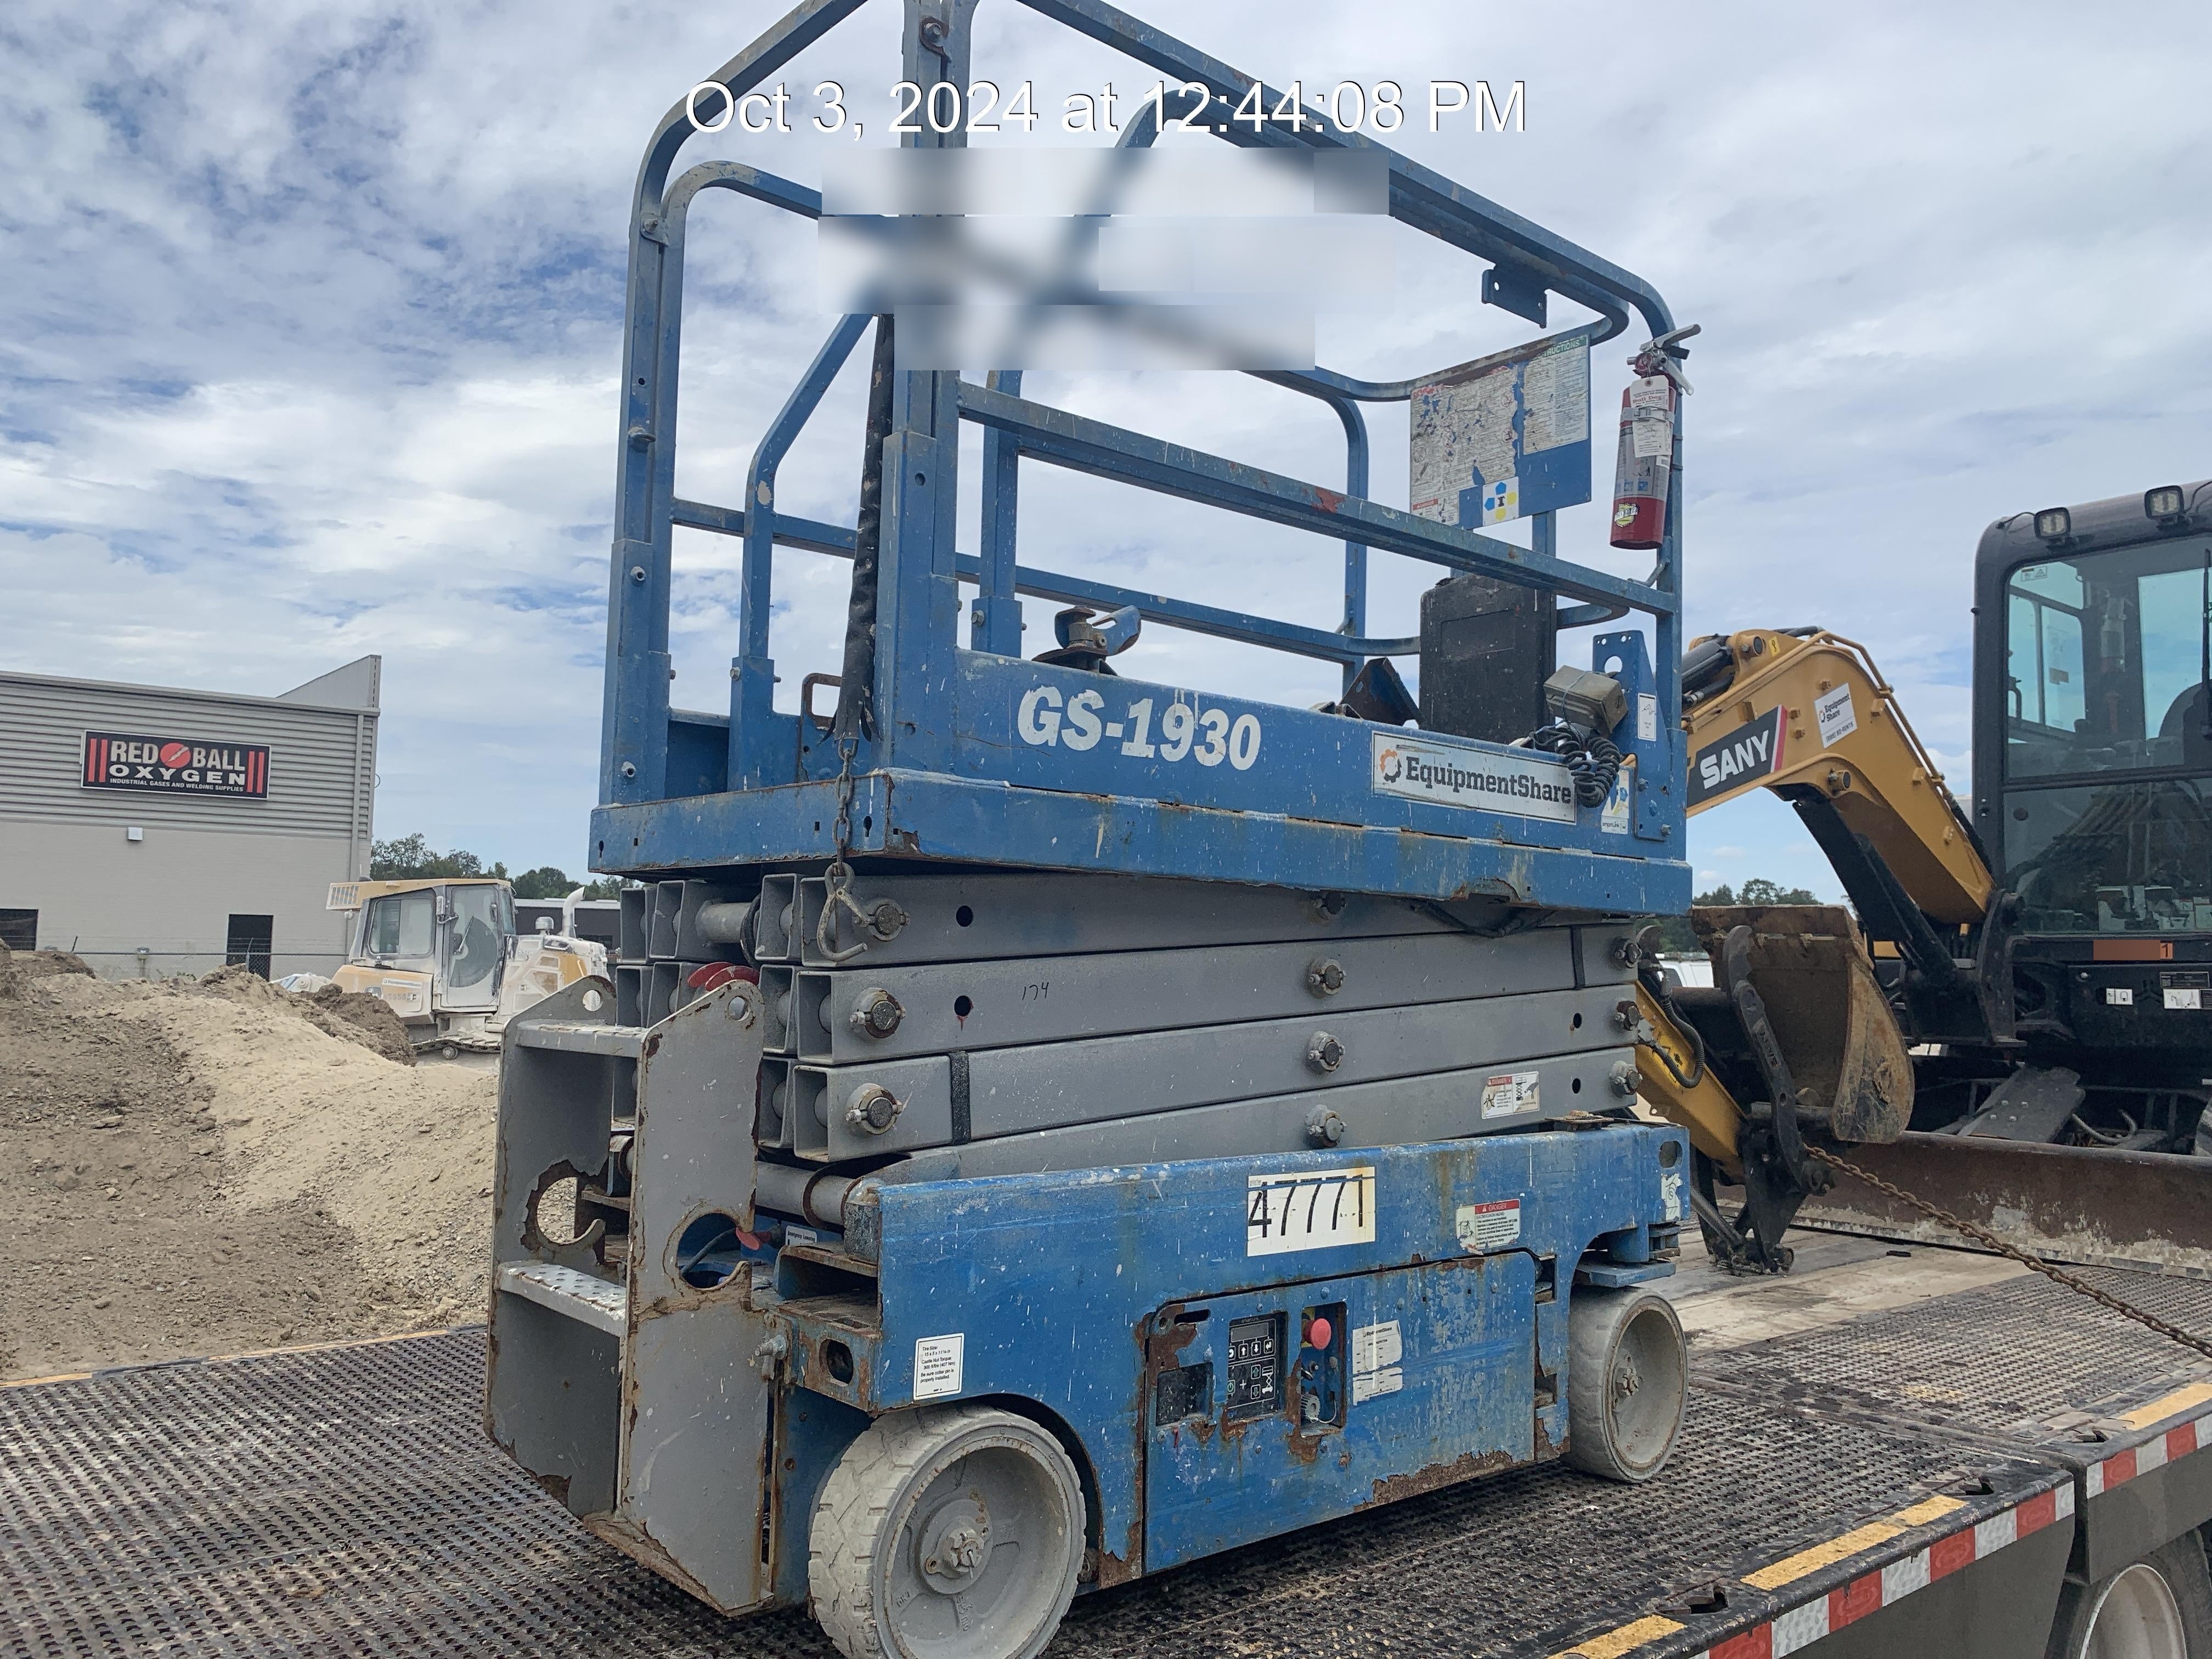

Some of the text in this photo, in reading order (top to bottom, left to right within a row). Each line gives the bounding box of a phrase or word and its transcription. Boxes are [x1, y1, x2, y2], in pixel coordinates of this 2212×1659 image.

[1824, 693, 1850, 713] Equipment
[1826, 709, 1840, 722] Share
[1017, 685, 1261, 771] GS-1930
[110, 740, 246, 771] RED BALL
[1700, 729, 1769, 789] SANY
[109, 764, 246, 786] OXYGEN
[110, 778, 148, 786] INDUSTRIAL
[1406, 755, 1572, 804] EquipmentShare
[1022, 982, 1049, 1001] 174
[1248, 1174, 1363, 1238] 47771
